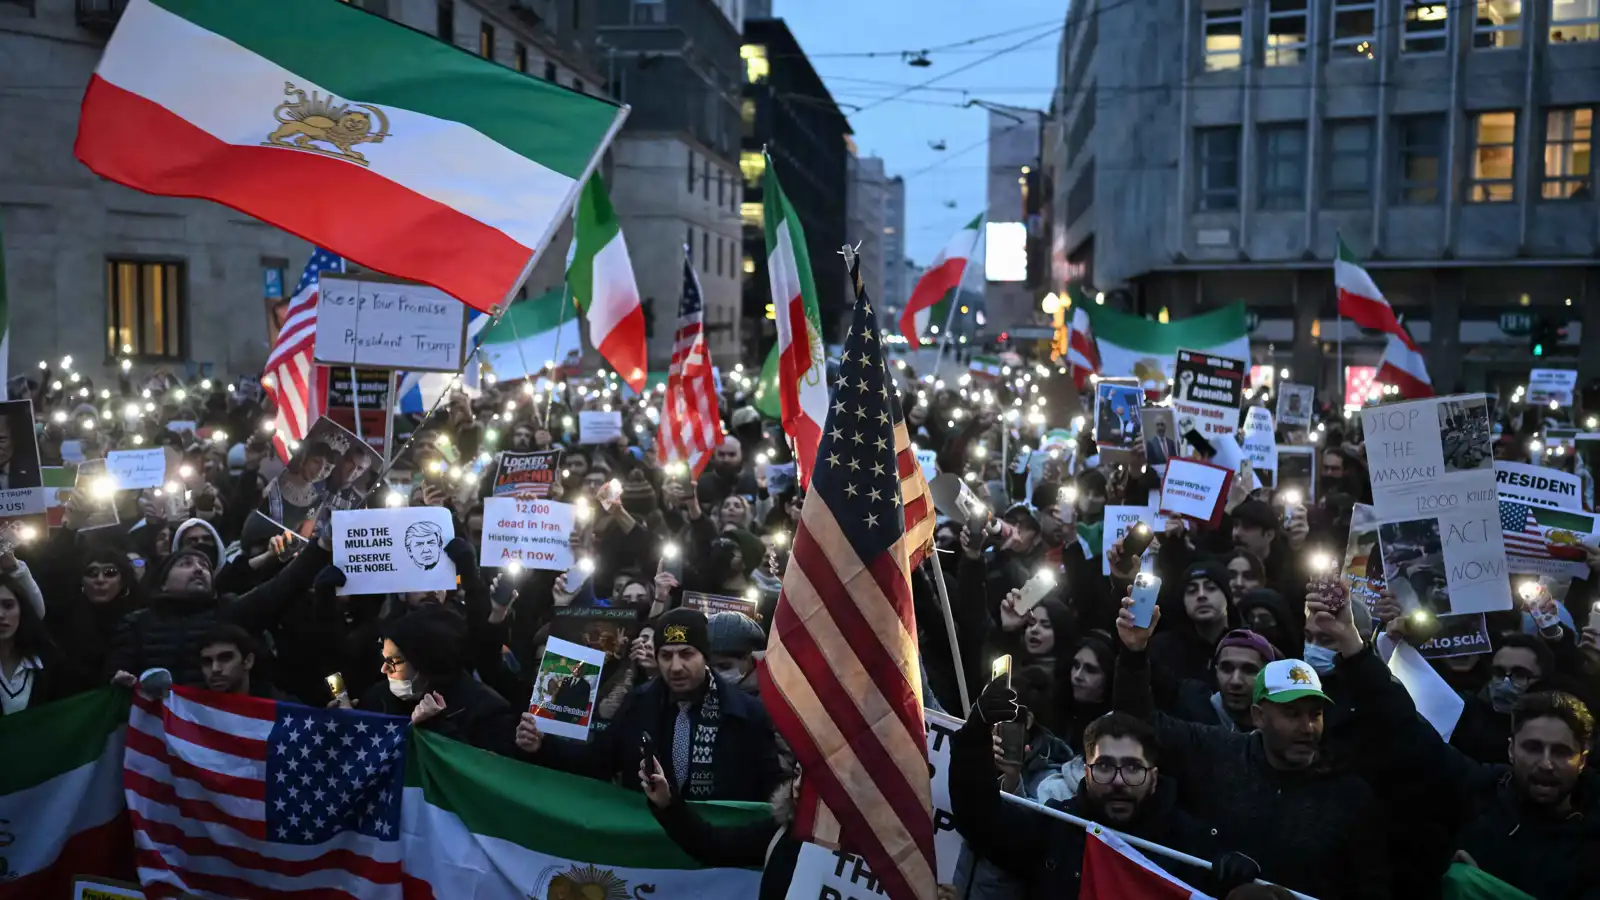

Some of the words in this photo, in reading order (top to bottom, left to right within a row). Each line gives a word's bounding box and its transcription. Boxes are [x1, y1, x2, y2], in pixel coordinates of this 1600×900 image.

[322, 289, 366, 311] Keep
[372, 293, 394, 310] Your
[398, 295, 447, 315] Promise
[344, 329, 402, 347] President
[411, 334, 455, 362] Trump
[1209, 377, 1232, 389] more
[1192, 386, 1233, 403] Ayatollah
[1174, 402, 1199, 416] Trump
[1370, 409, 1420, 435] STOP
[1383, 441, 1416, 459] THE
[1373, 466, 1437, 482] MASSACRE
[1495, 470, 1576, 496] RESIDENT
[6, 490, 32, 498] TRUMP
[6, 502, 25, 511] US!
[1416, 494, 1458, 511] 12000
[515, 504, 550, 514] 12,000
[498, 520, 524, 528] dead
[527, 520, 538, 528] in
[1116, 514, 1140, 522] YOUR
[347, 528, 368, 538] END
[371, 527, 389, 536] THE
[1446, 518, 1490, 543] ACT
[345, 538, 393, 549] MULLAHS
[488, 534, 518, 544] History
[348, 553, 391, 563] DESERVE
[501, 548, 522, 559] Act
[344, 564, 362, 573] THE
[364, 563, 398, 573] NOBEL.
[1434, 638, 1451, 648] LO
[1453, 631, 1485, 646] SCIÀ
